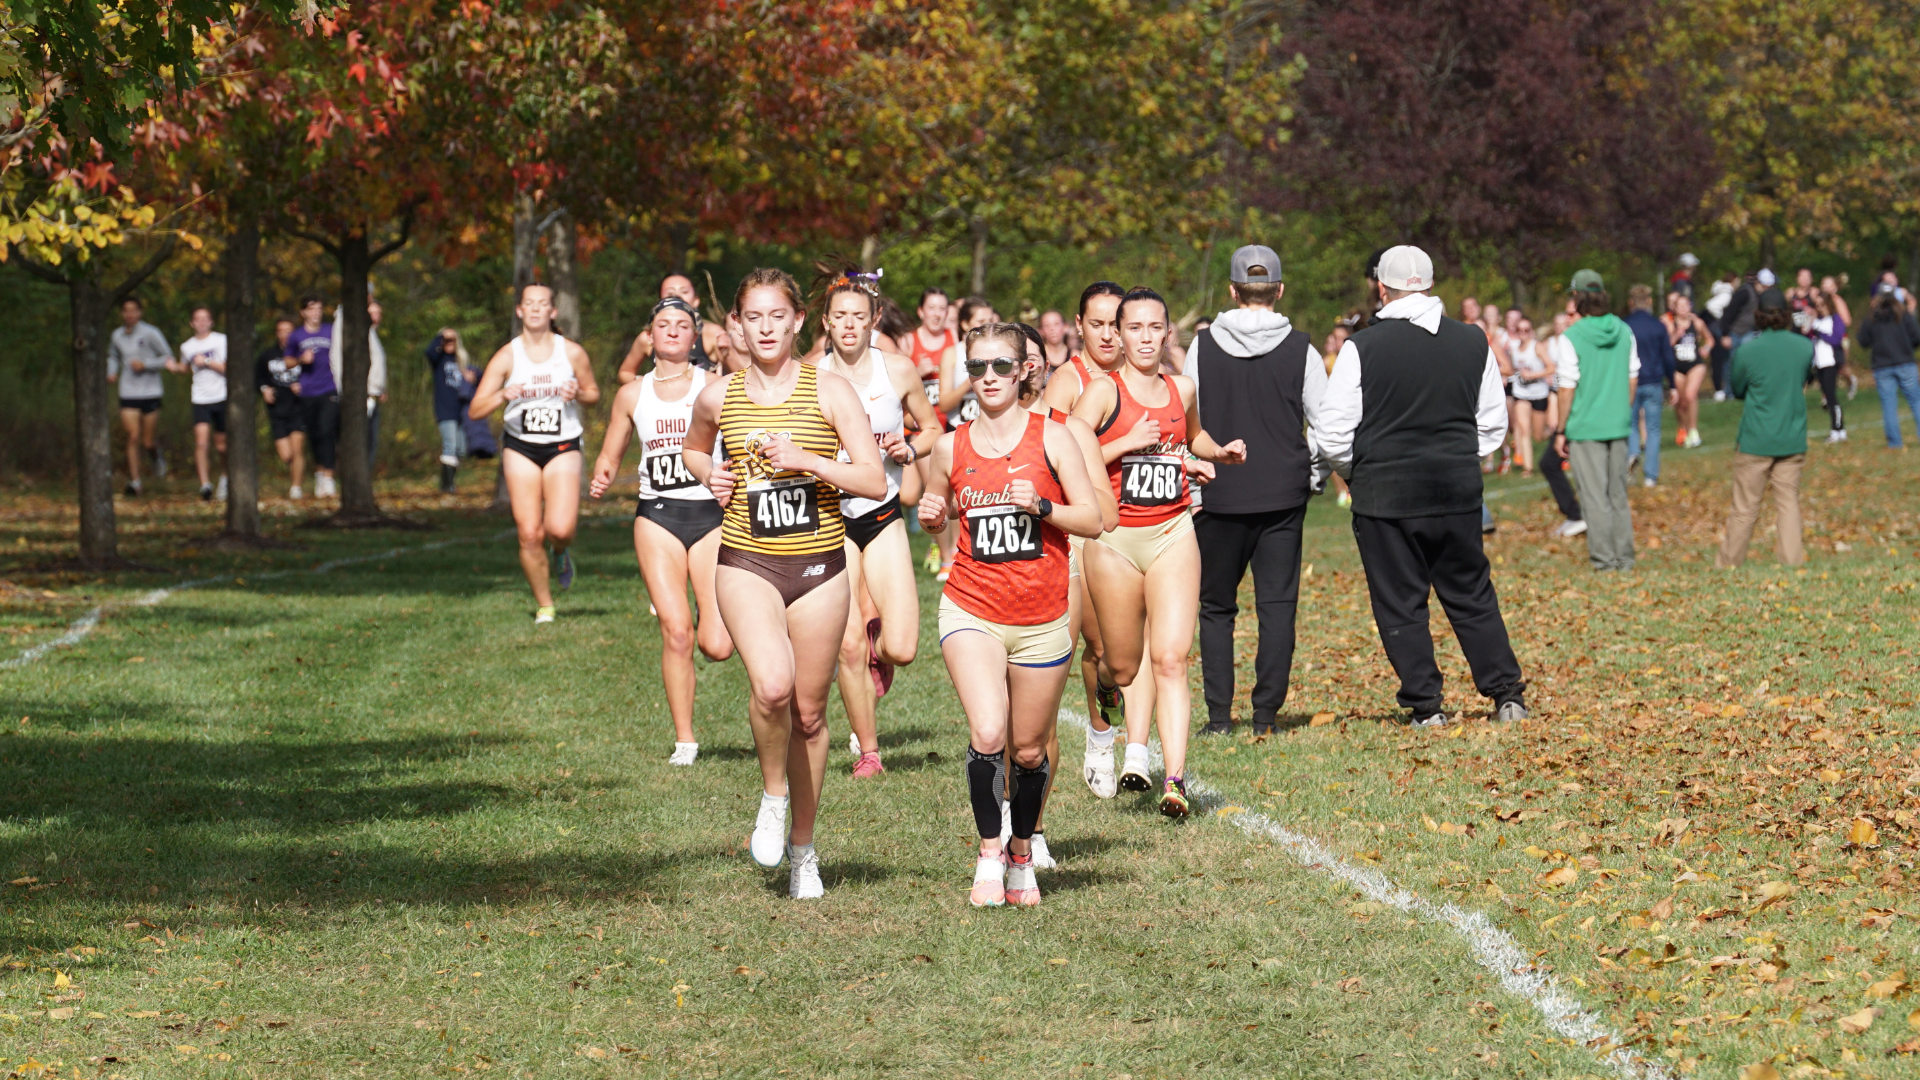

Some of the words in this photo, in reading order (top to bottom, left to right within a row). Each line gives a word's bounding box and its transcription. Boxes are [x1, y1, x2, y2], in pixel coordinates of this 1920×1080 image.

[532, 374, 552, 384] OHIO
[524, 408, 559, 432] 4252
[656, 418, 686, 434] OHIO
[1126, 463, 1177, 500] 4268
[756, 487, 810, 529] 4162
[959, 483, 1012, 509] Otterb
[976, 514, 1036, 556] 4262
